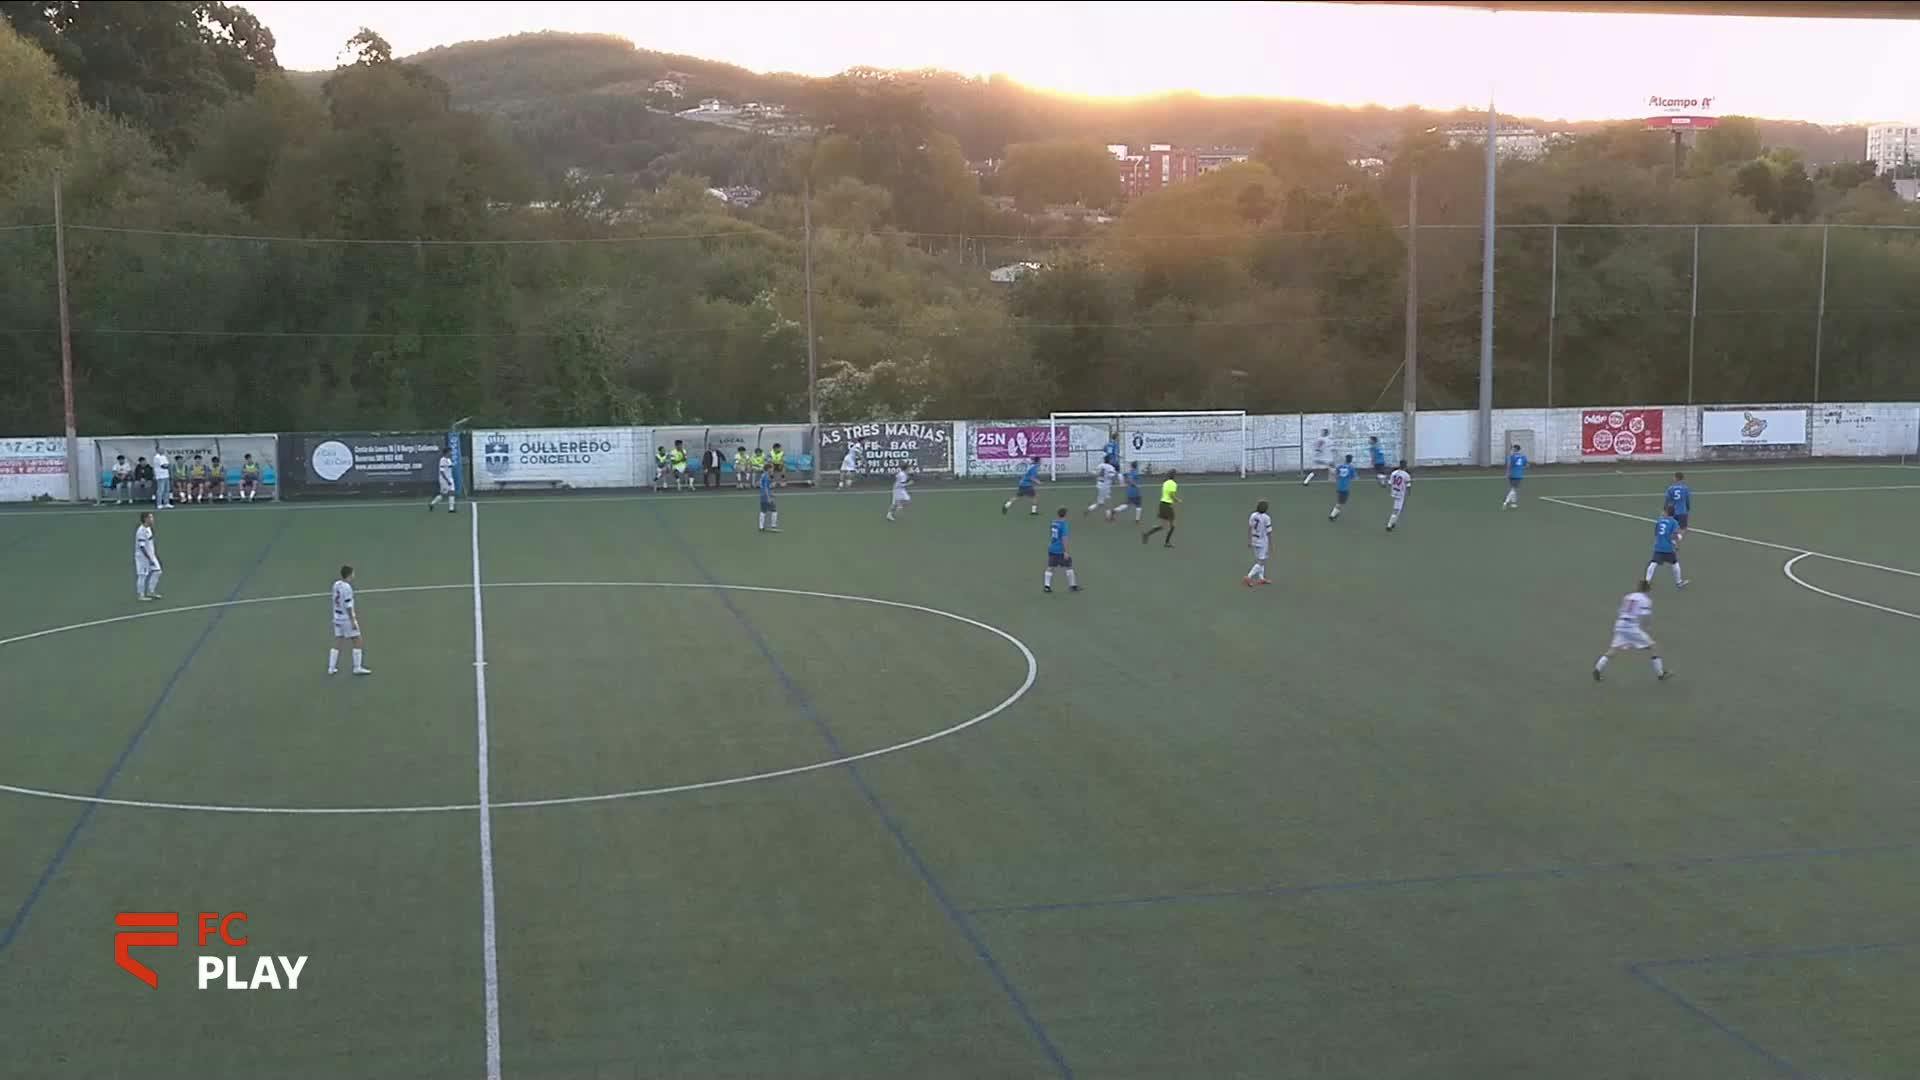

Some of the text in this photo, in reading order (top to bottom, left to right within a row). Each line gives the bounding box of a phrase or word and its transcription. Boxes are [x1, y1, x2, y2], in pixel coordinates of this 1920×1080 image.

[1648, 96, 1698, 108] Alcampo
[844, 424, 880, 440] TRES
[886, 424, 945, 443] MARIAS
[978, 433, 1007, 445] 25N
[890, 441, 918, 450] BAR
[520, 455, 591, 465] CONCELLO
[866, 451, 910, 459] BURGO
[1392, 474, 1403, 487] 10
[1673, 490, 1681, 500] 5
[1254, 518, 1260, 530] 7
[1659, 523, 1667, 535] 3
